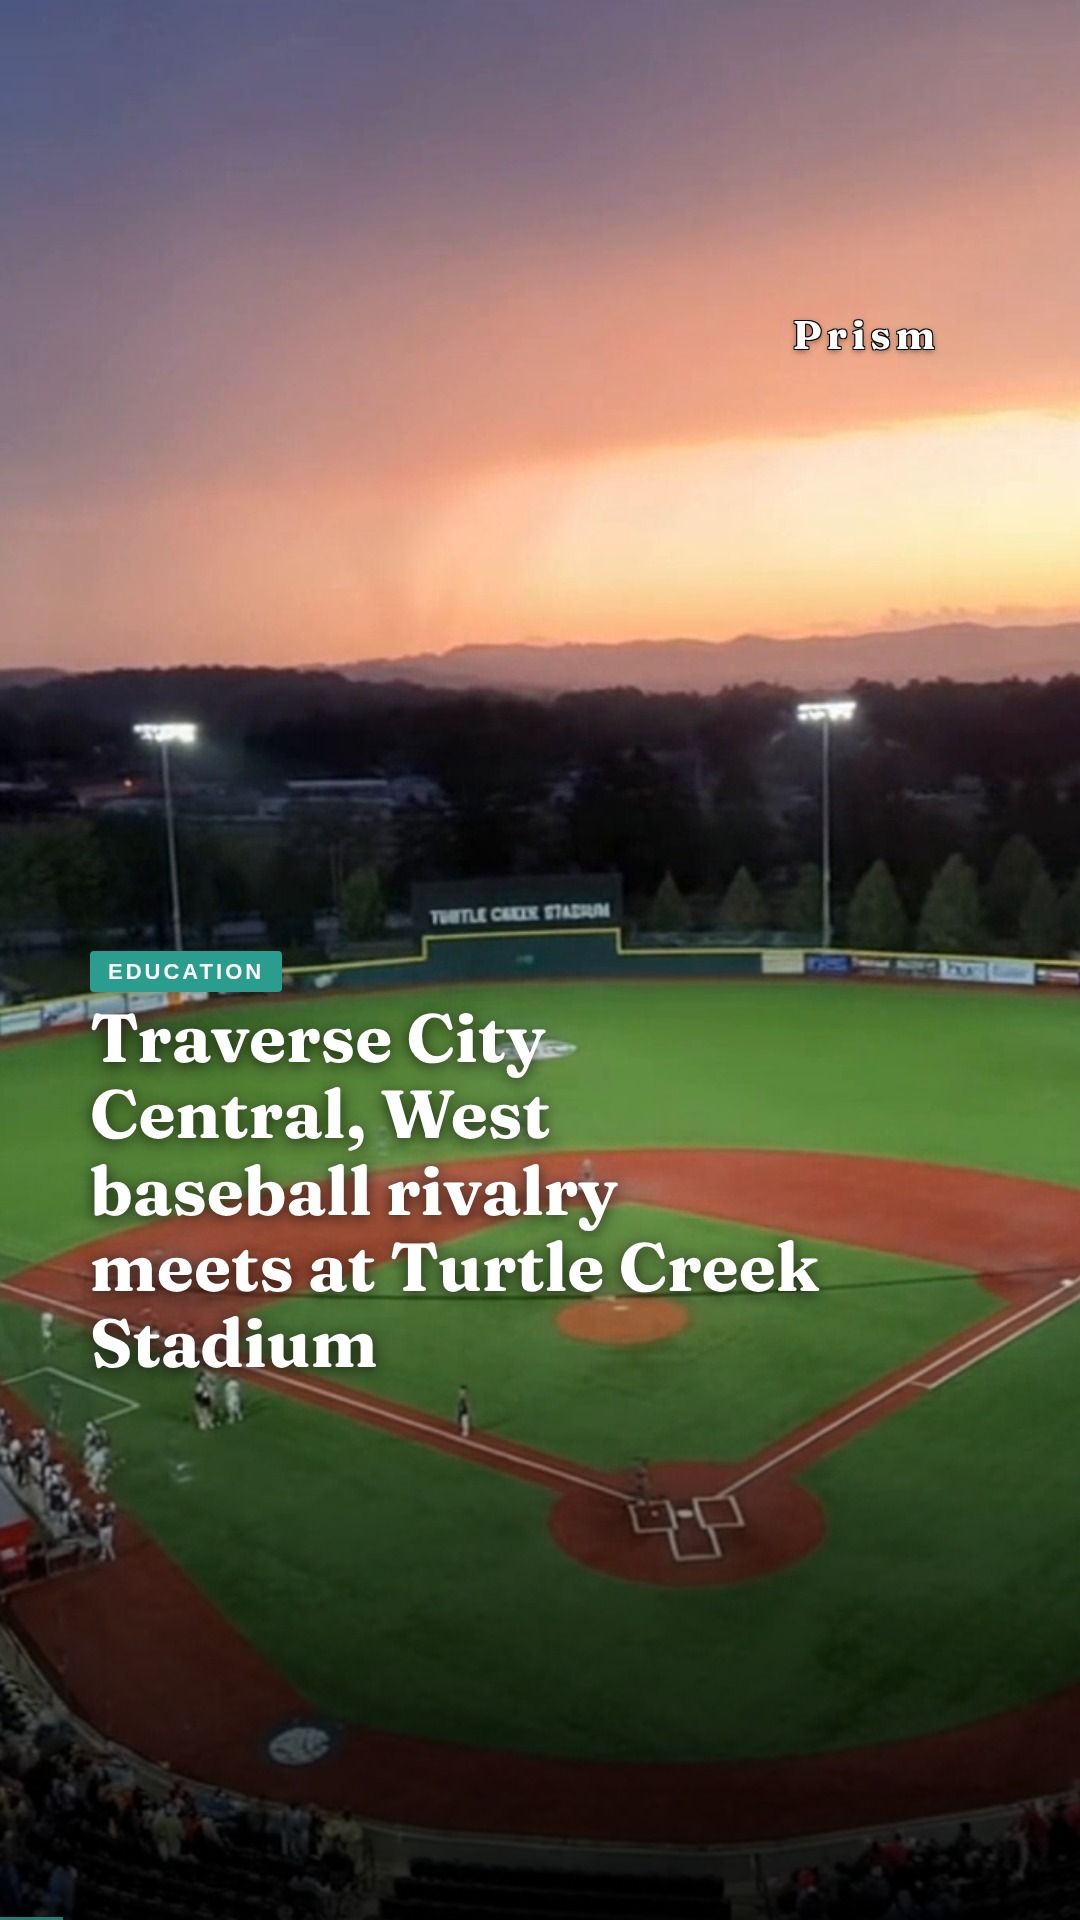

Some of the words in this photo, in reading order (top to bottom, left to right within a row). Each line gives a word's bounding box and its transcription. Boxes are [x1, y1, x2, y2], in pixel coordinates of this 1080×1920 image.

[429, 907, 488, 926] TURTLE
[490, 905, 541, 922] CREEK
[543, 902, 611, 921] STADIUM
